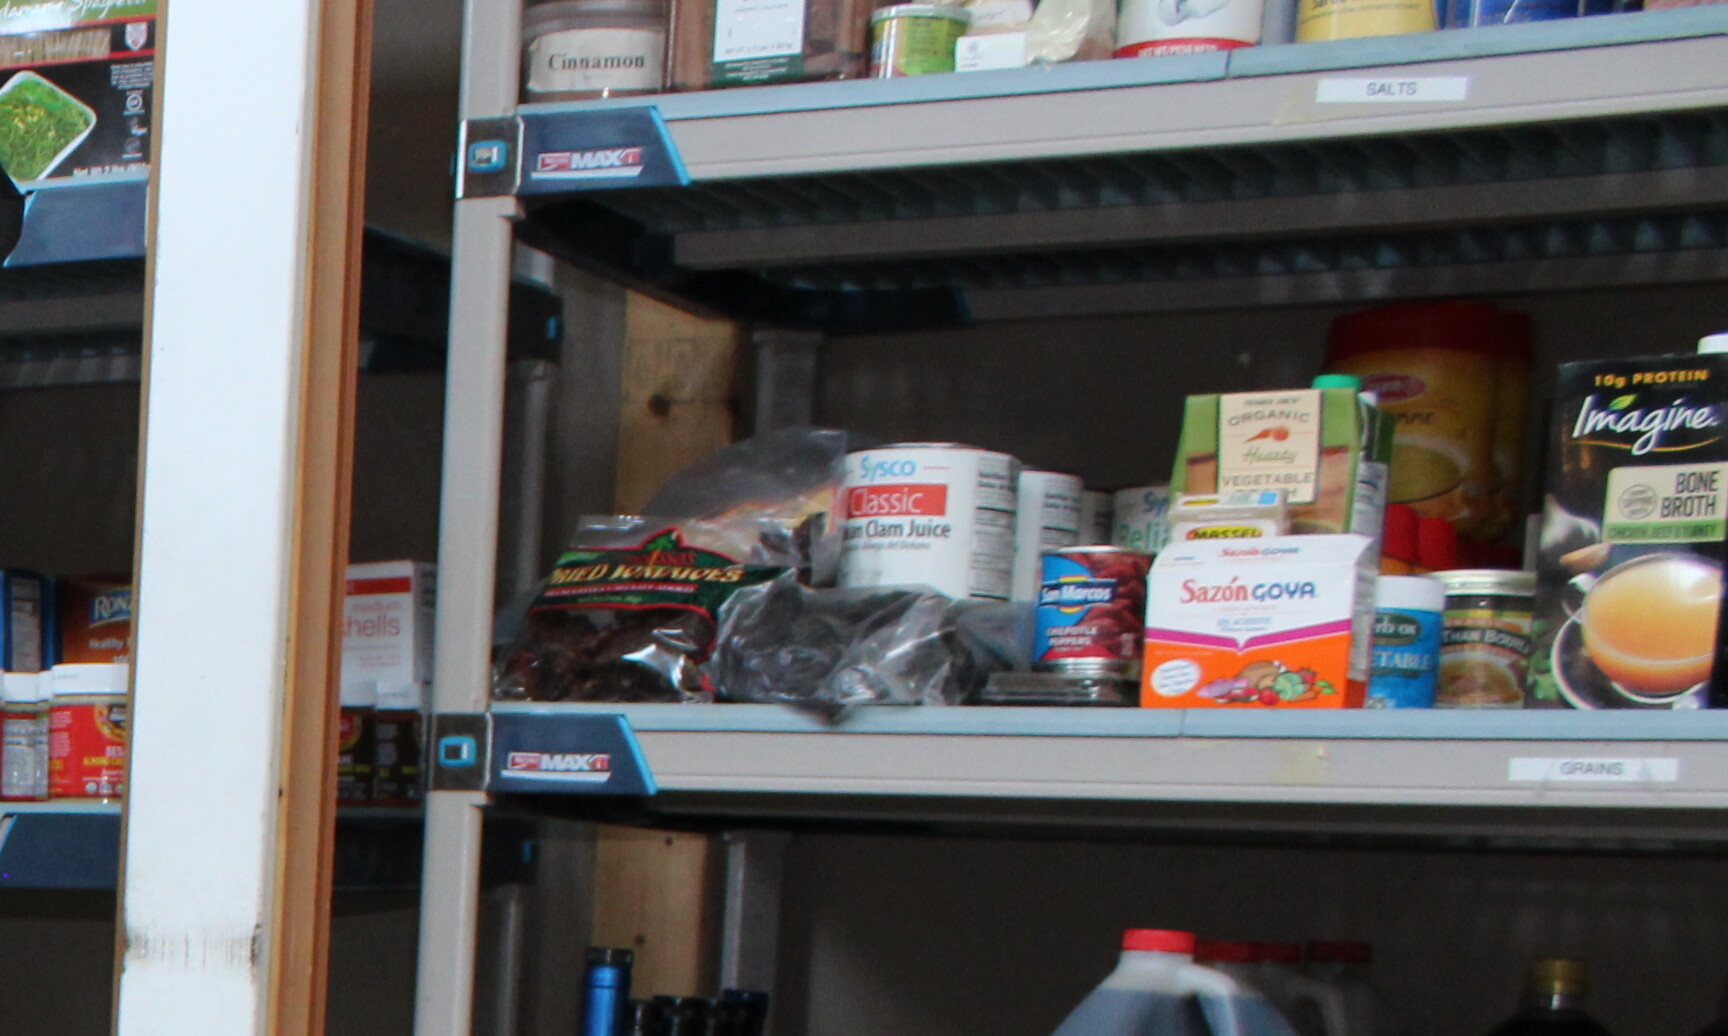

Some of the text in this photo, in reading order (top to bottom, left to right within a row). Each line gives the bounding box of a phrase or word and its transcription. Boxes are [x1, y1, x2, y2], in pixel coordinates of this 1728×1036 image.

[548, 52, 646, 71] Cinnamon
[1365, 81, 1417, 97] SALTS
[1595, 369, 1711, 389] 10g PROTEIN
[1228, 409, 1311, 427] ORGANIC
[1571, 392, 1716, 456] Imagine
[860, 456, 917, 483] Sysco
[1222, 471, 1315, 488] VEGETABLE
[1674, 470, 1721, 494] BONE
[849, 489, 923, 516] Classic
[1660, 495, 1717, 519] BROTH
[865, 518, 904, 538] Clam
[907, 518, 952, 538] Juice
[1061, 586, 1112, 602] Marcos
[1180, 575, 1317, 604] Sazón GOYA
[1560, 761, 1623, 776] GRAINS
